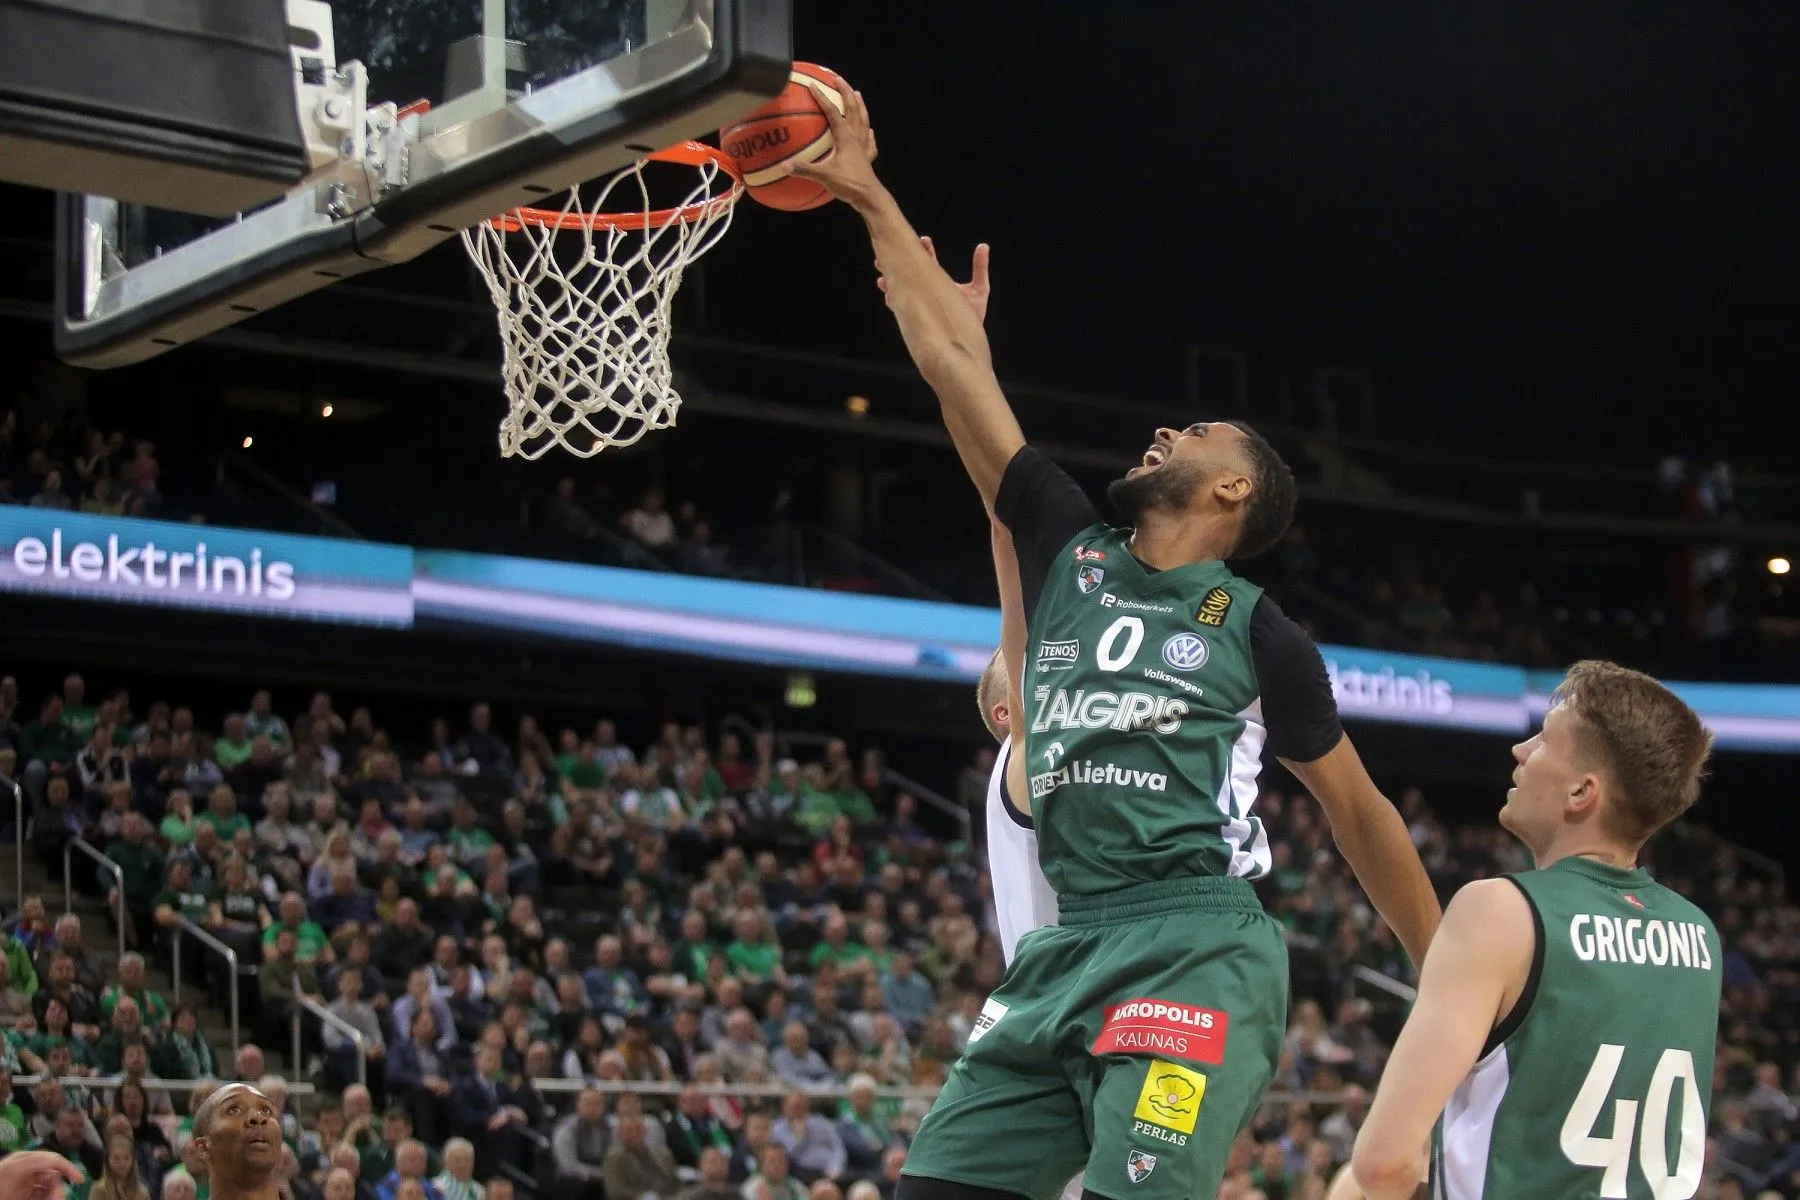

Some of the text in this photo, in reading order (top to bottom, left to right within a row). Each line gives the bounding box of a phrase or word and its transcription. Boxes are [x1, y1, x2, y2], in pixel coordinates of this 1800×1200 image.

[14, 528, 296, 599] elektrinis
[1198, 611, 1221, 626] LKL
[1096, 615, 1145, 672] 0
[1143, 667, 1204, 697] Volkswagen
[1073, 760, 1168, 792] Lietuva
[1570, 914, 1712, 970] GRIGONIS
[1112, 1002, 1215, 1029] AKROPOLIS
[1115, 1032, 1188, 1053] KAUNAS
[1133, 1120, 1188, 1147] PERLAS
[1559, 1043, 1706, 1200] 40
